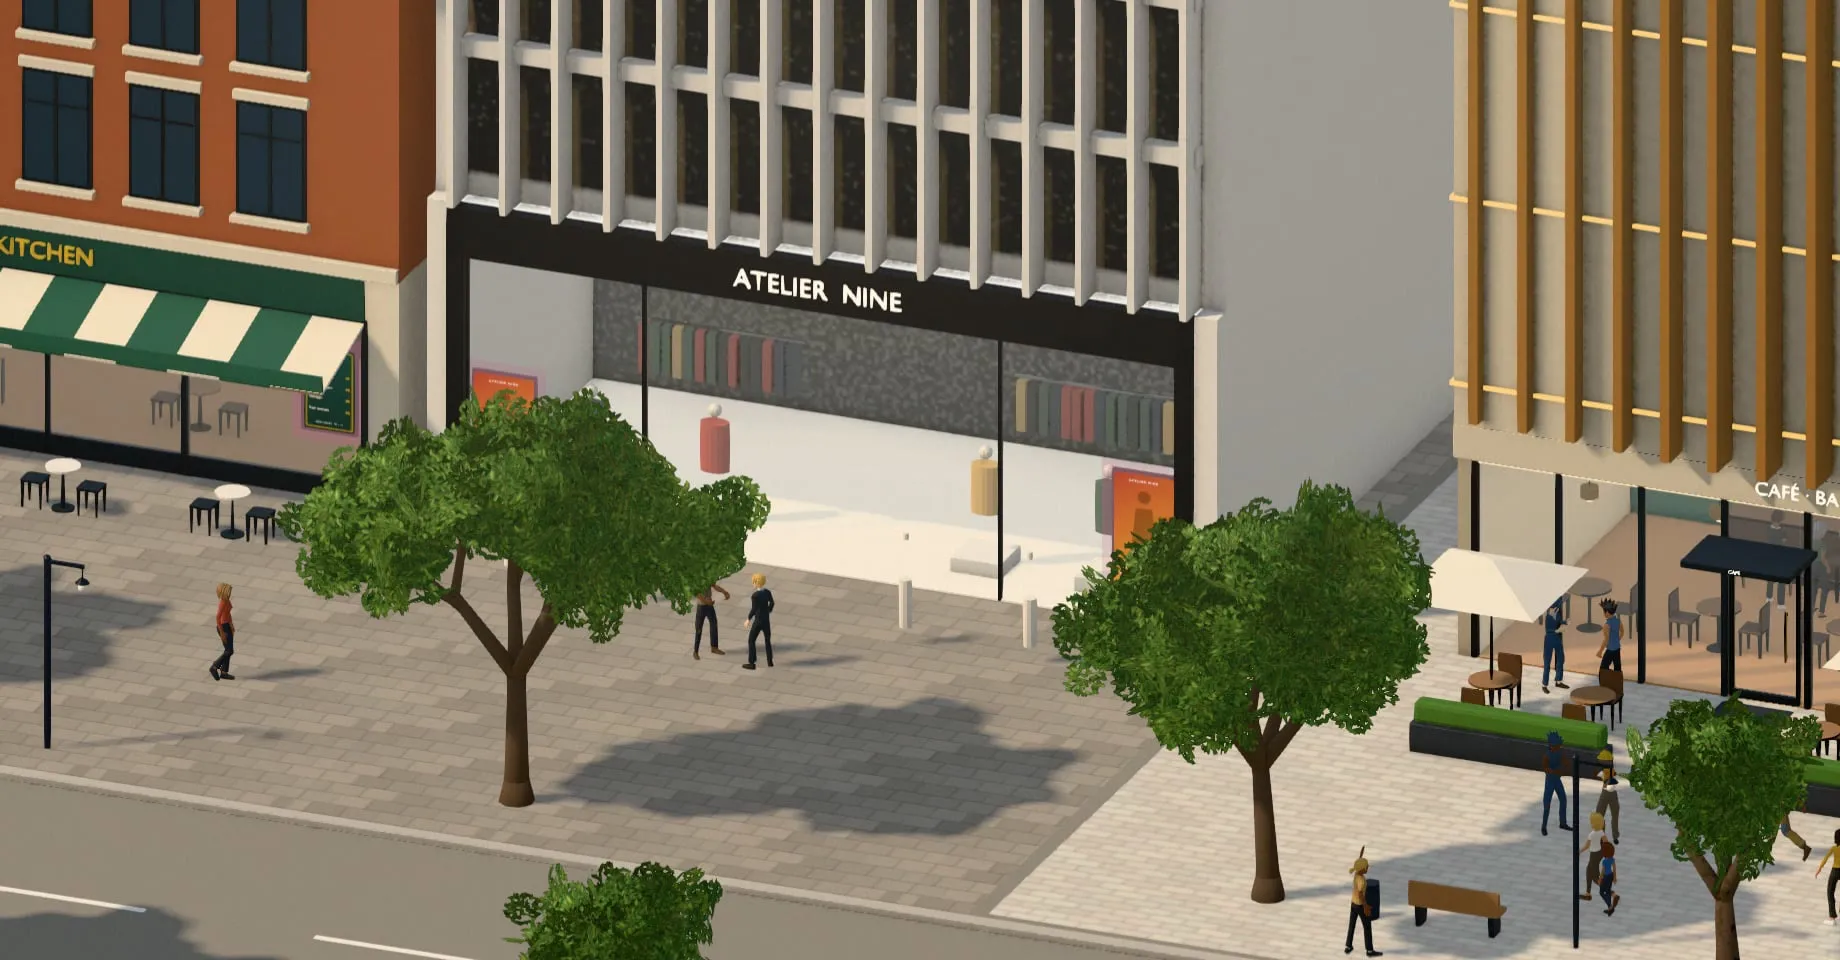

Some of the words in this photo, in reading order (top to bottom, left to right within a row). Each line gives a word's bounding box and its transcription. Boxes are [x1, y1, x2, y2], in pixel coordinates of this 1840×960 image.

[0, 236, 94, 267] KITCHEN
[732, 267, 829, 302] ATELIER
[842, 283, 903, 313] NINE
[1755, 481, 1800, 502] CAFÉ
